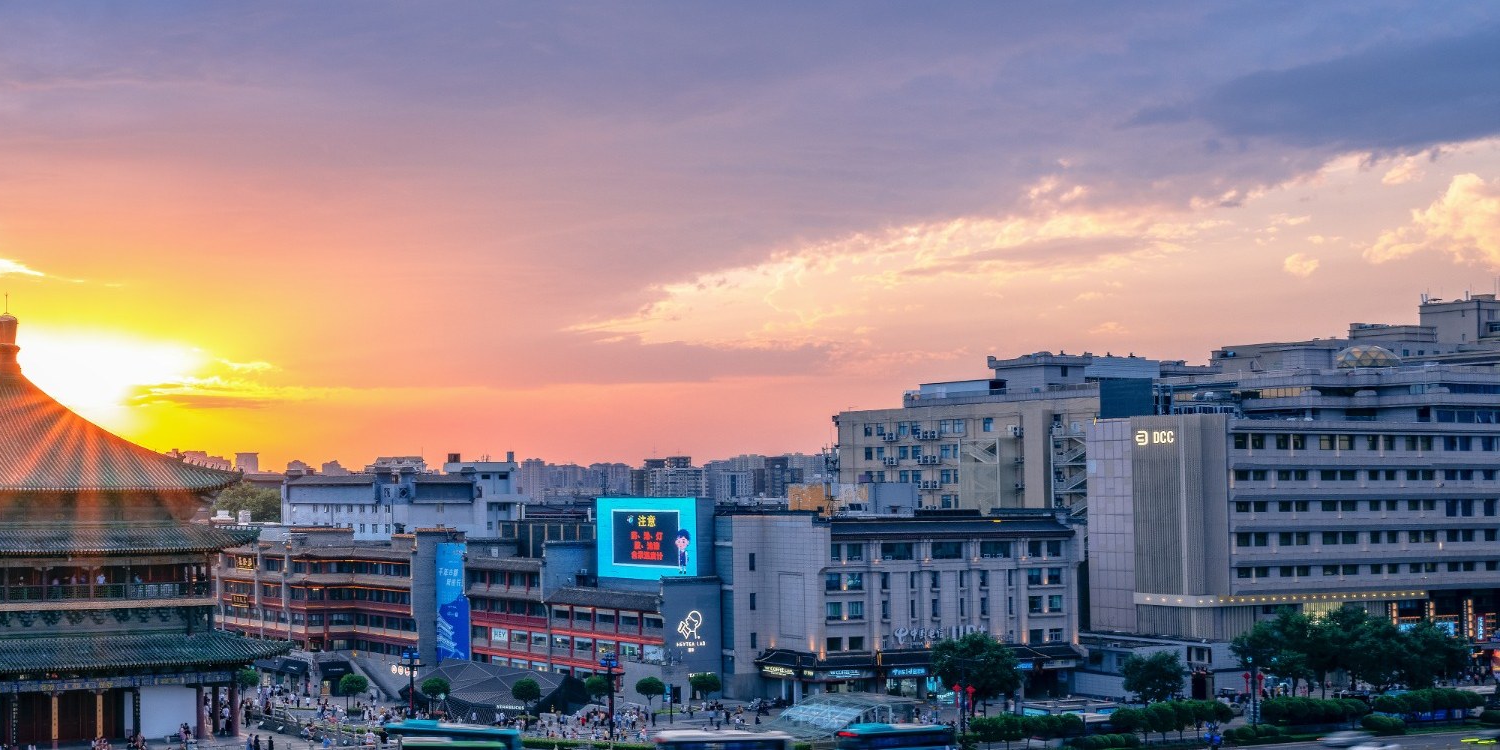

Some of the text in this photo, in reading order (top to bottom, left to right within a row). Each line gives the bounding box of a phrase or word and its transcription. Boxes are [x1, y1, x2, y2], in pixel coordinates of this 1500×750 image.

[1153, 430, 1174, 444] DCC
[637, 514, 656, 527] 注意
[910, 627, 944, 641] 中国电信
